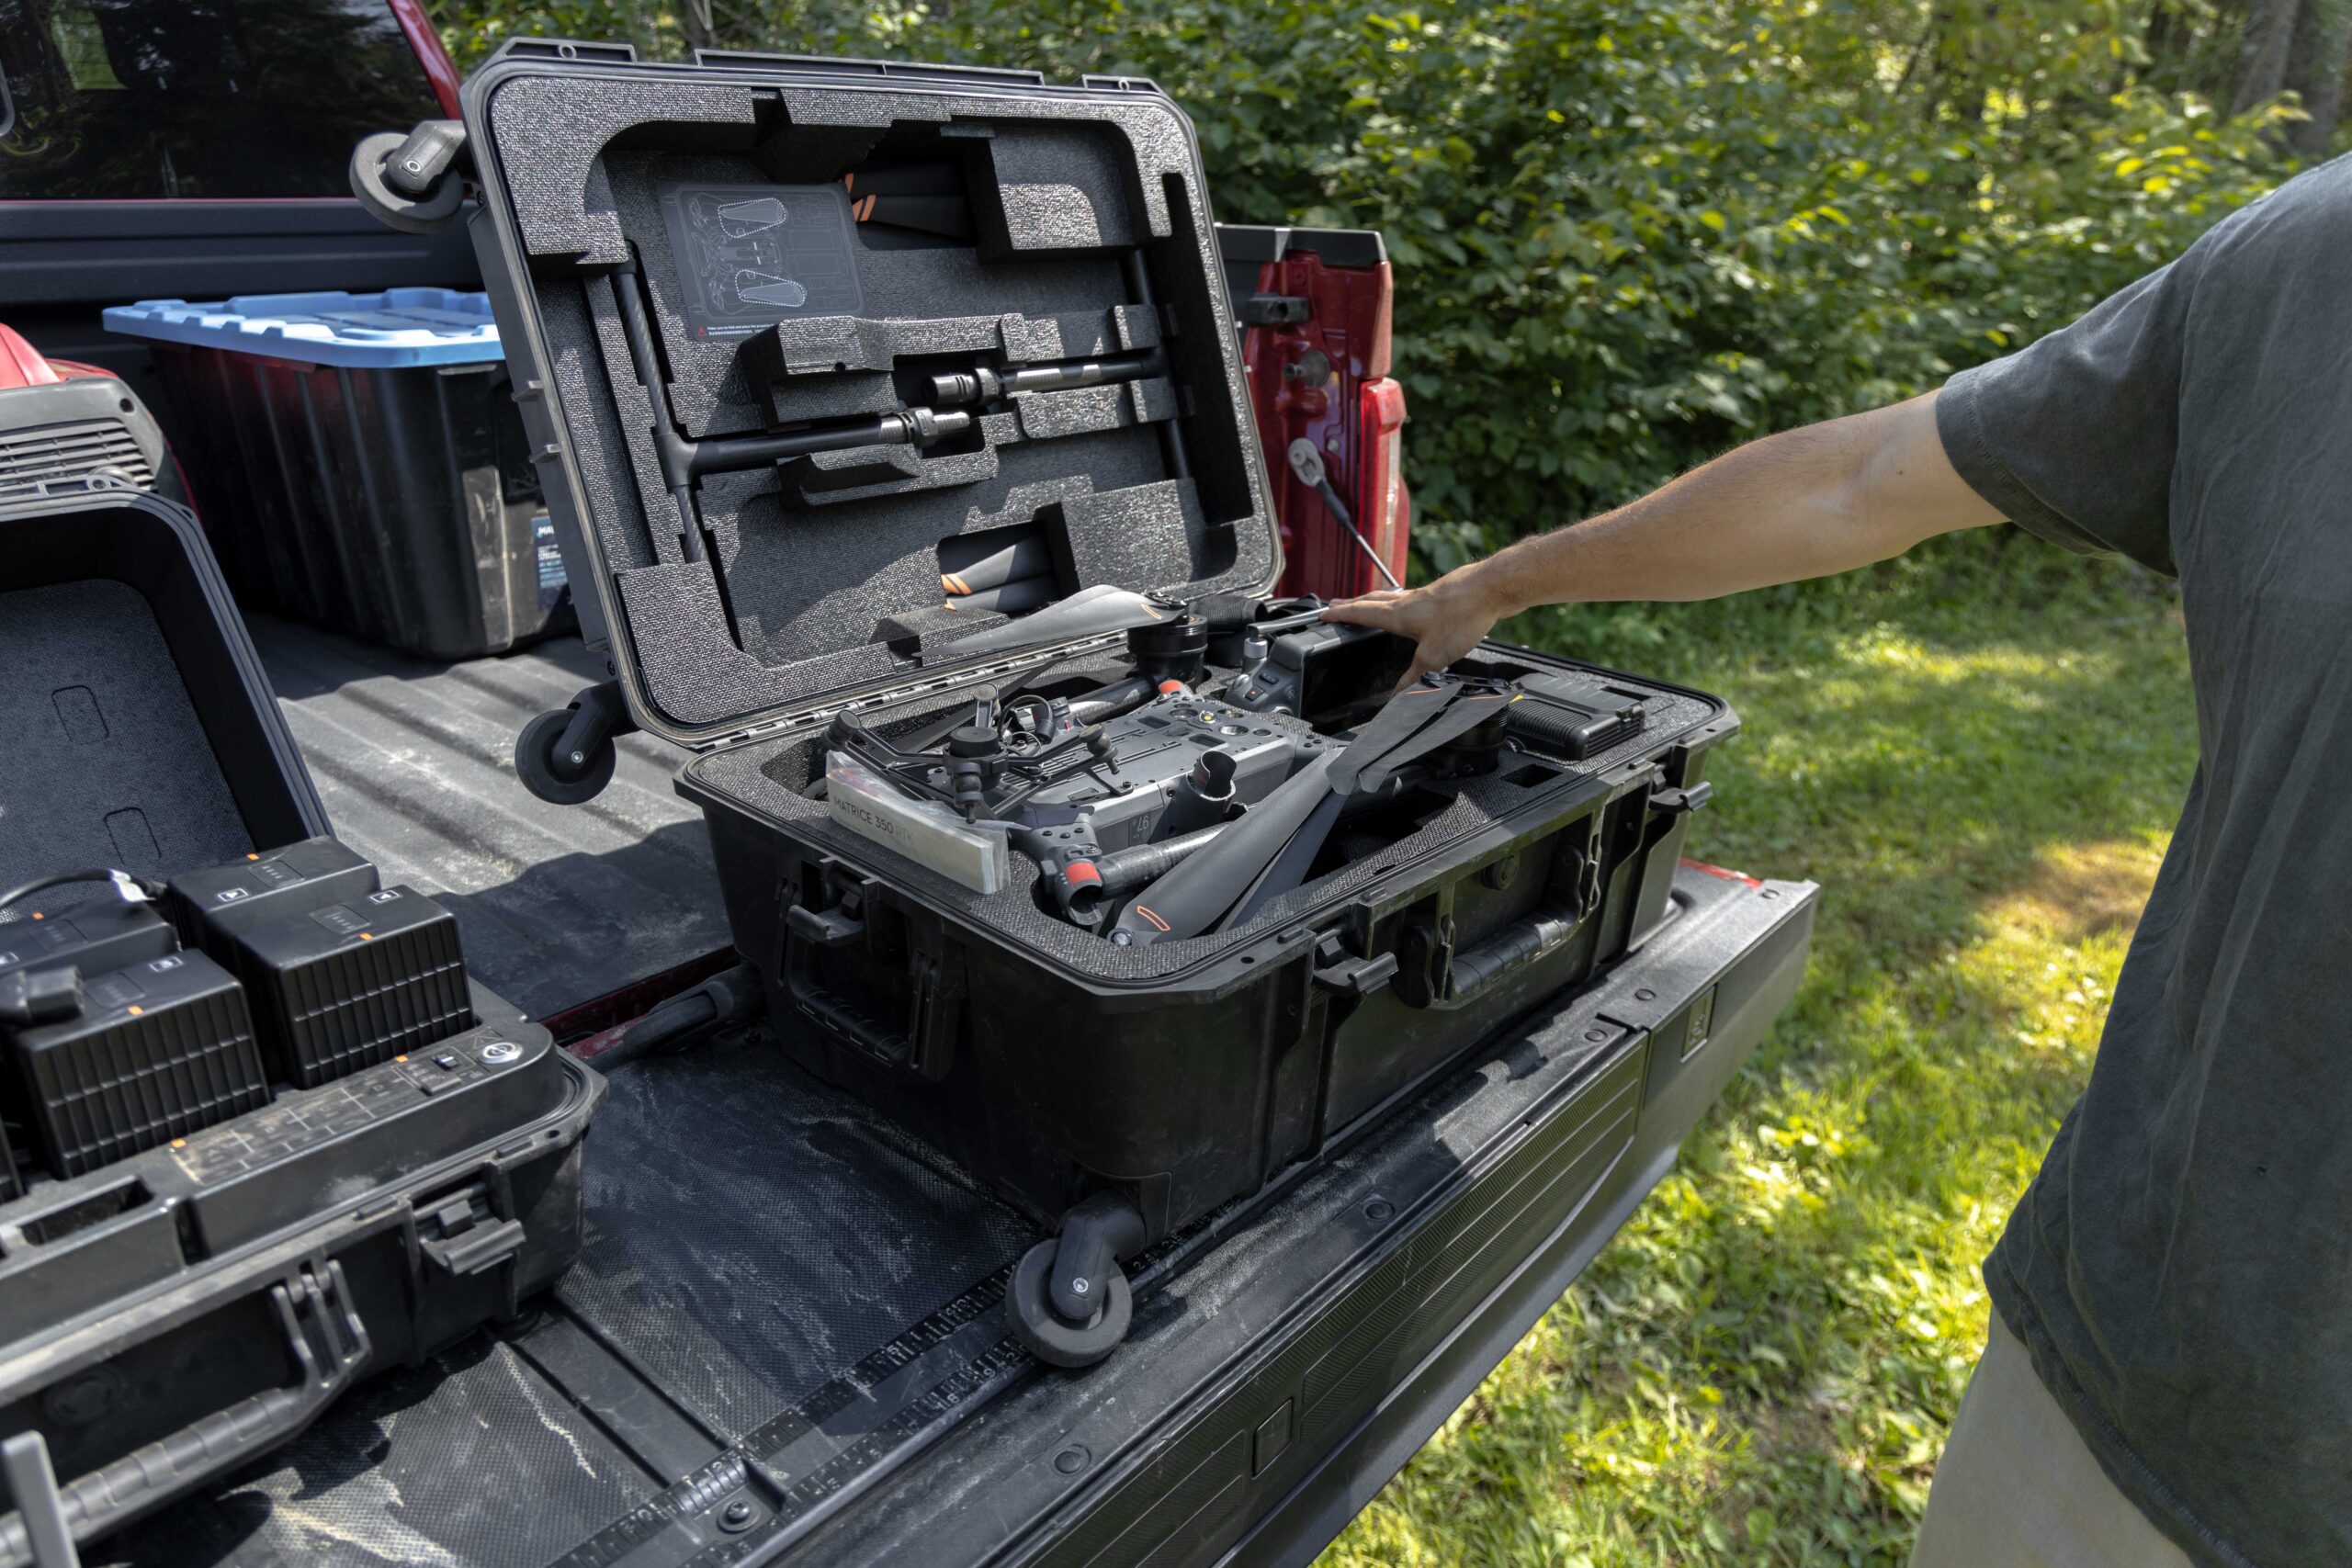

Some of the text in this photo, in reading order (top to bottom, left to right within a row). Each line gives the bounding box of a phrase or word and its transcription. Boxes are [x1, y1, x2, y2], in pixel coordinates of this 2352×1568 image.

[833, 796, 873, 824] MATRICE
[875, 817, 894, 834] 350
[895, 826, 913, 841] RTK
